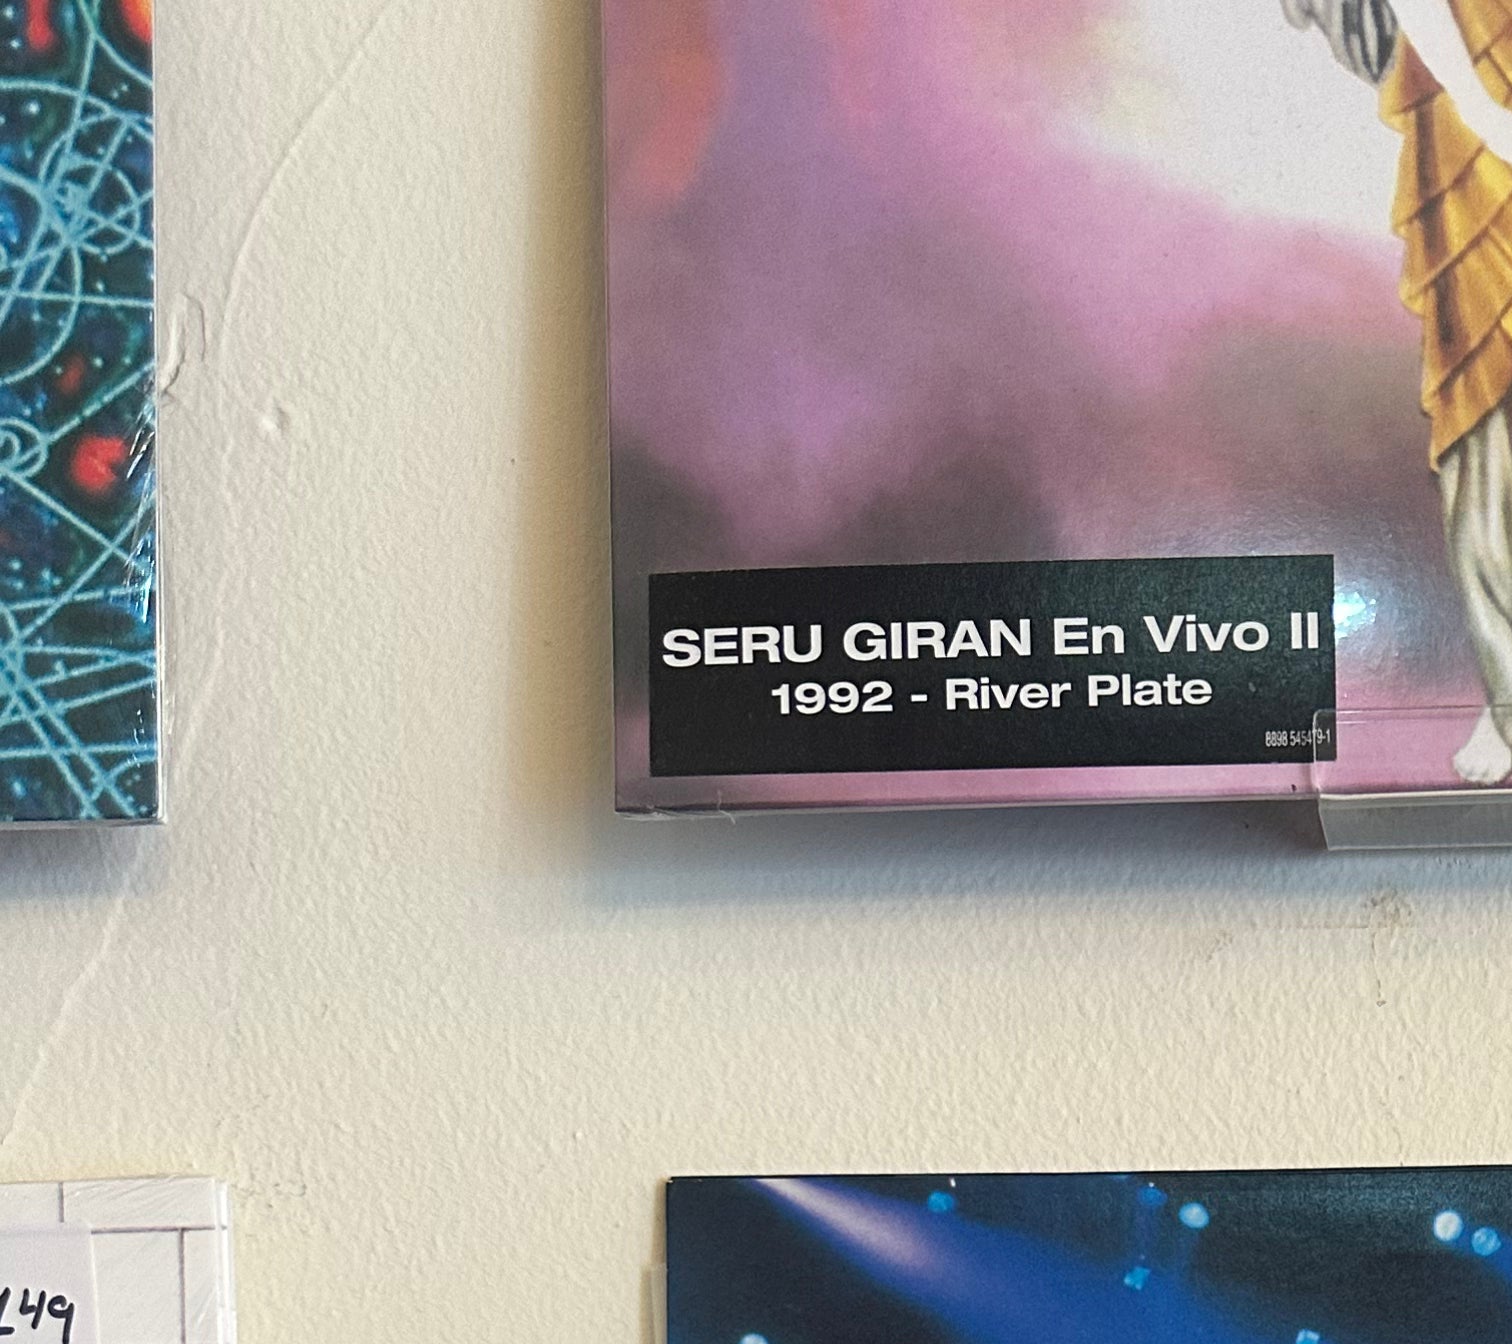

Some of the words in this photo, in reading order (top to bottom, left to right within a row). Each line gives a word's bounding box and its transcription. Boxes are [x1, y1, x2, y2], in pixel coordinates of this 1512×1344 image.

[662, 625, 822, 667] SERU
[844, 618, 1032, 661] GIRAN
[1054, 617, 1125, 655] En
[1143, 612, 1268, 652] Vivo
[1290, 612, 1319, 649] II
[771, 680, 894, 715] 1992
[910, 694, 929, 703] -
[945, 676, 1071, 711] River
[1088, 673, 1212, 708] Plate
